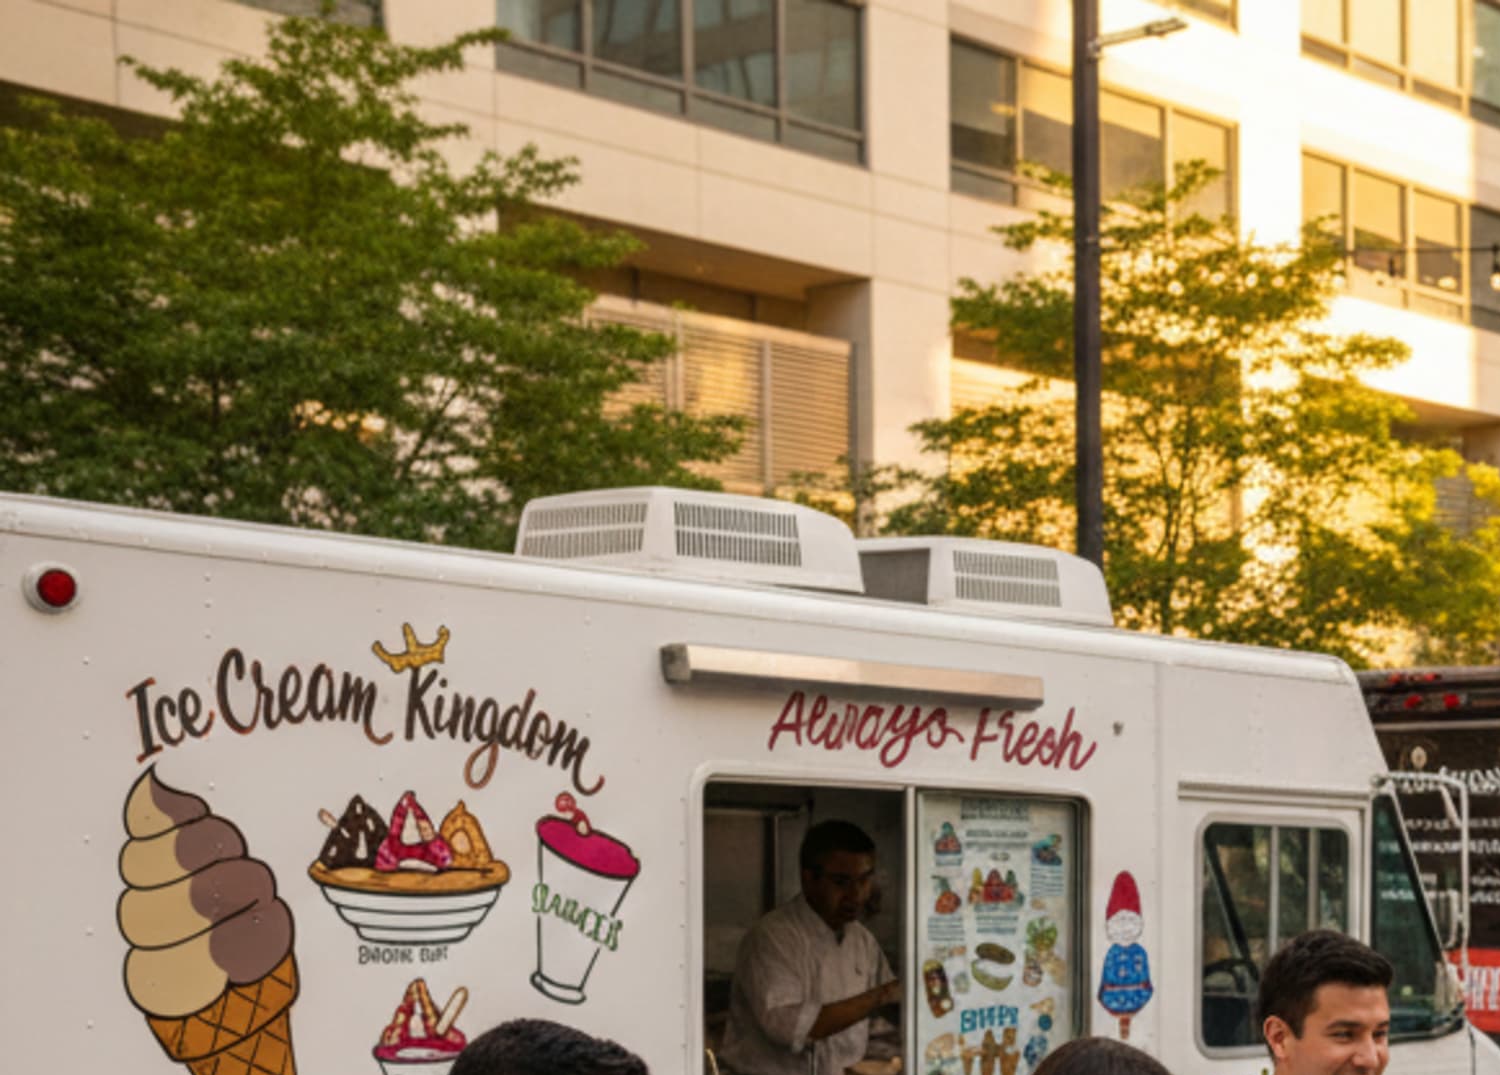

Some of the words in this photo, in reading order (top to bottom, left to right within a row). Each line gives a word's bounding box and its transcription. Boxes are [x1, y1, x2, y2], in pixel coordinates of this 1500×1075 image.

[126, 677, 213, 763] Ice
[216, 648, 393, 745] Cream
[403, 664, 605, 796] Kingdom
